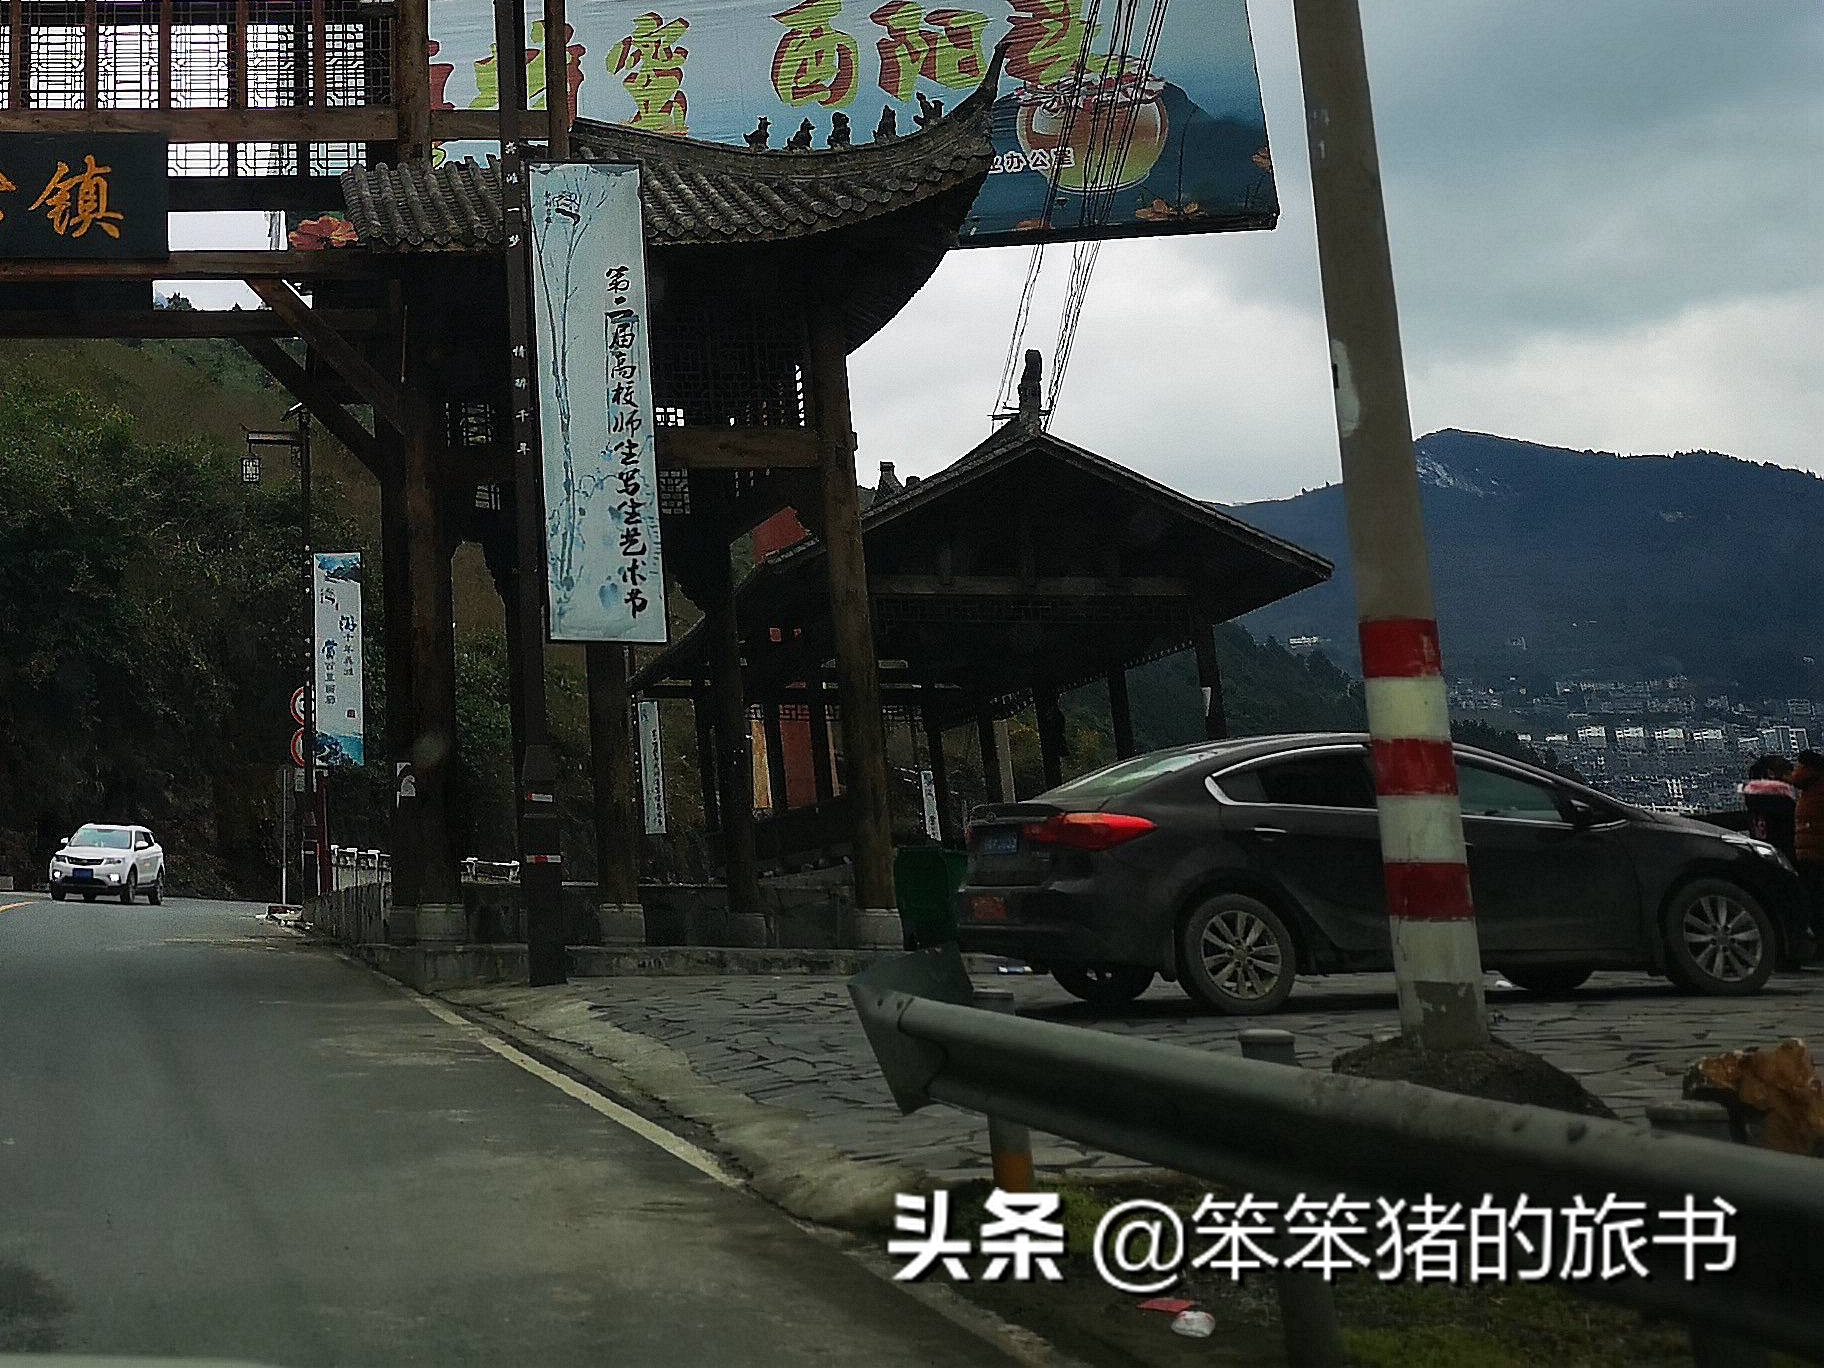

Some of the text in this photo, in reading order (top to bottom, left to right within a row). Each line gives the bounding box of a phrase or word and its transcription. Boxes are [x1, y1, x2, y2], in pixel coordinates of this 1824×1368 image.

[605, 265, 648, 619] 第二届高校师生写生艺术节
